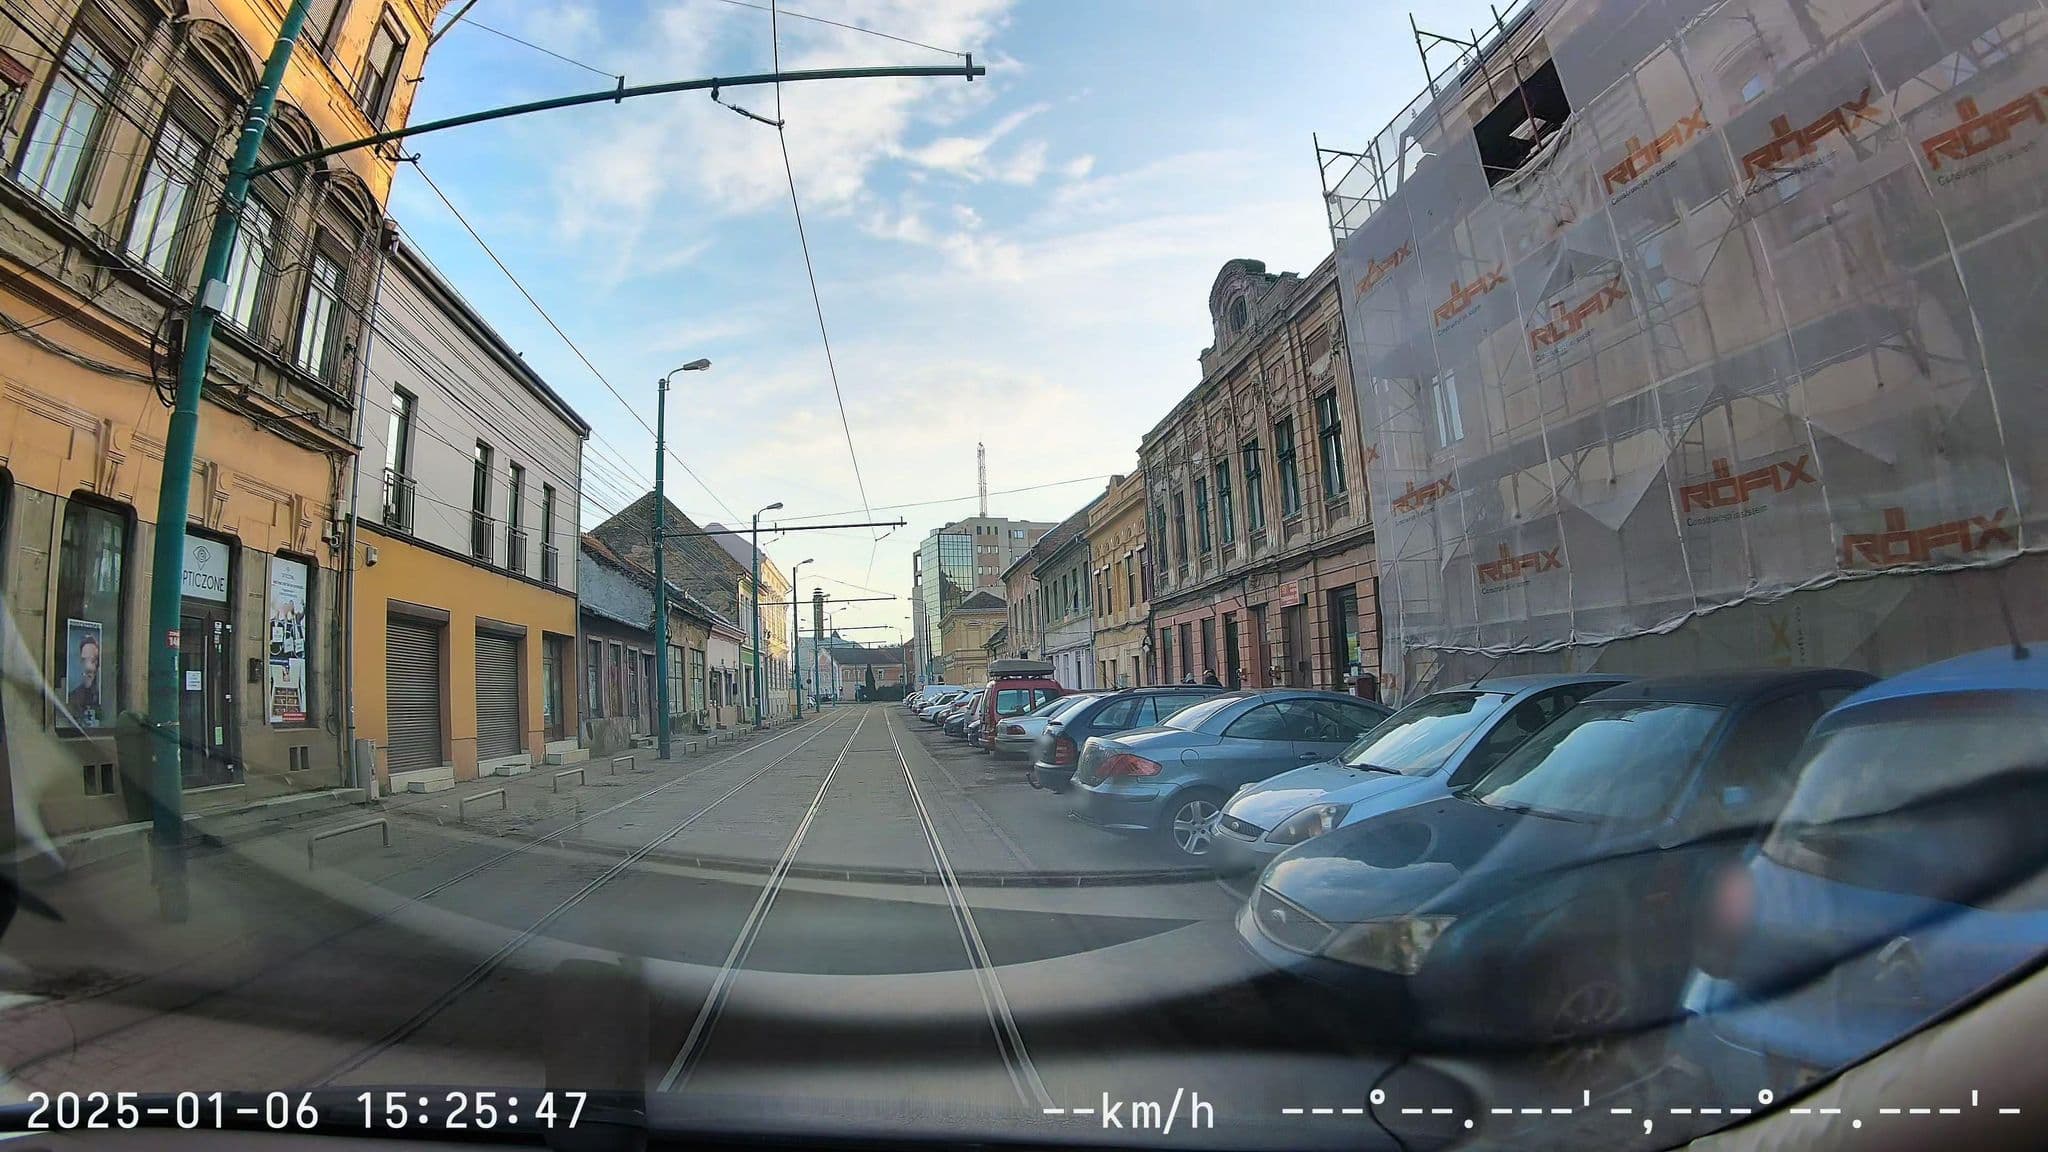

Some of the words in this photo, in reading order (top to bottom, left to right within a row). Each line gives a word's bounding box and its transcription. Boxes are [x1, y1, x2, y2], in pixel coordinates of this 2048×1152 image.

[1679, 453, 1818, 514] RÖFIX
[1839, 506, 2015, 566] RÖFIX
[182, 569, 225, 593] PTICZONE
[1476, 542, 1564, 586] RÖFIX
